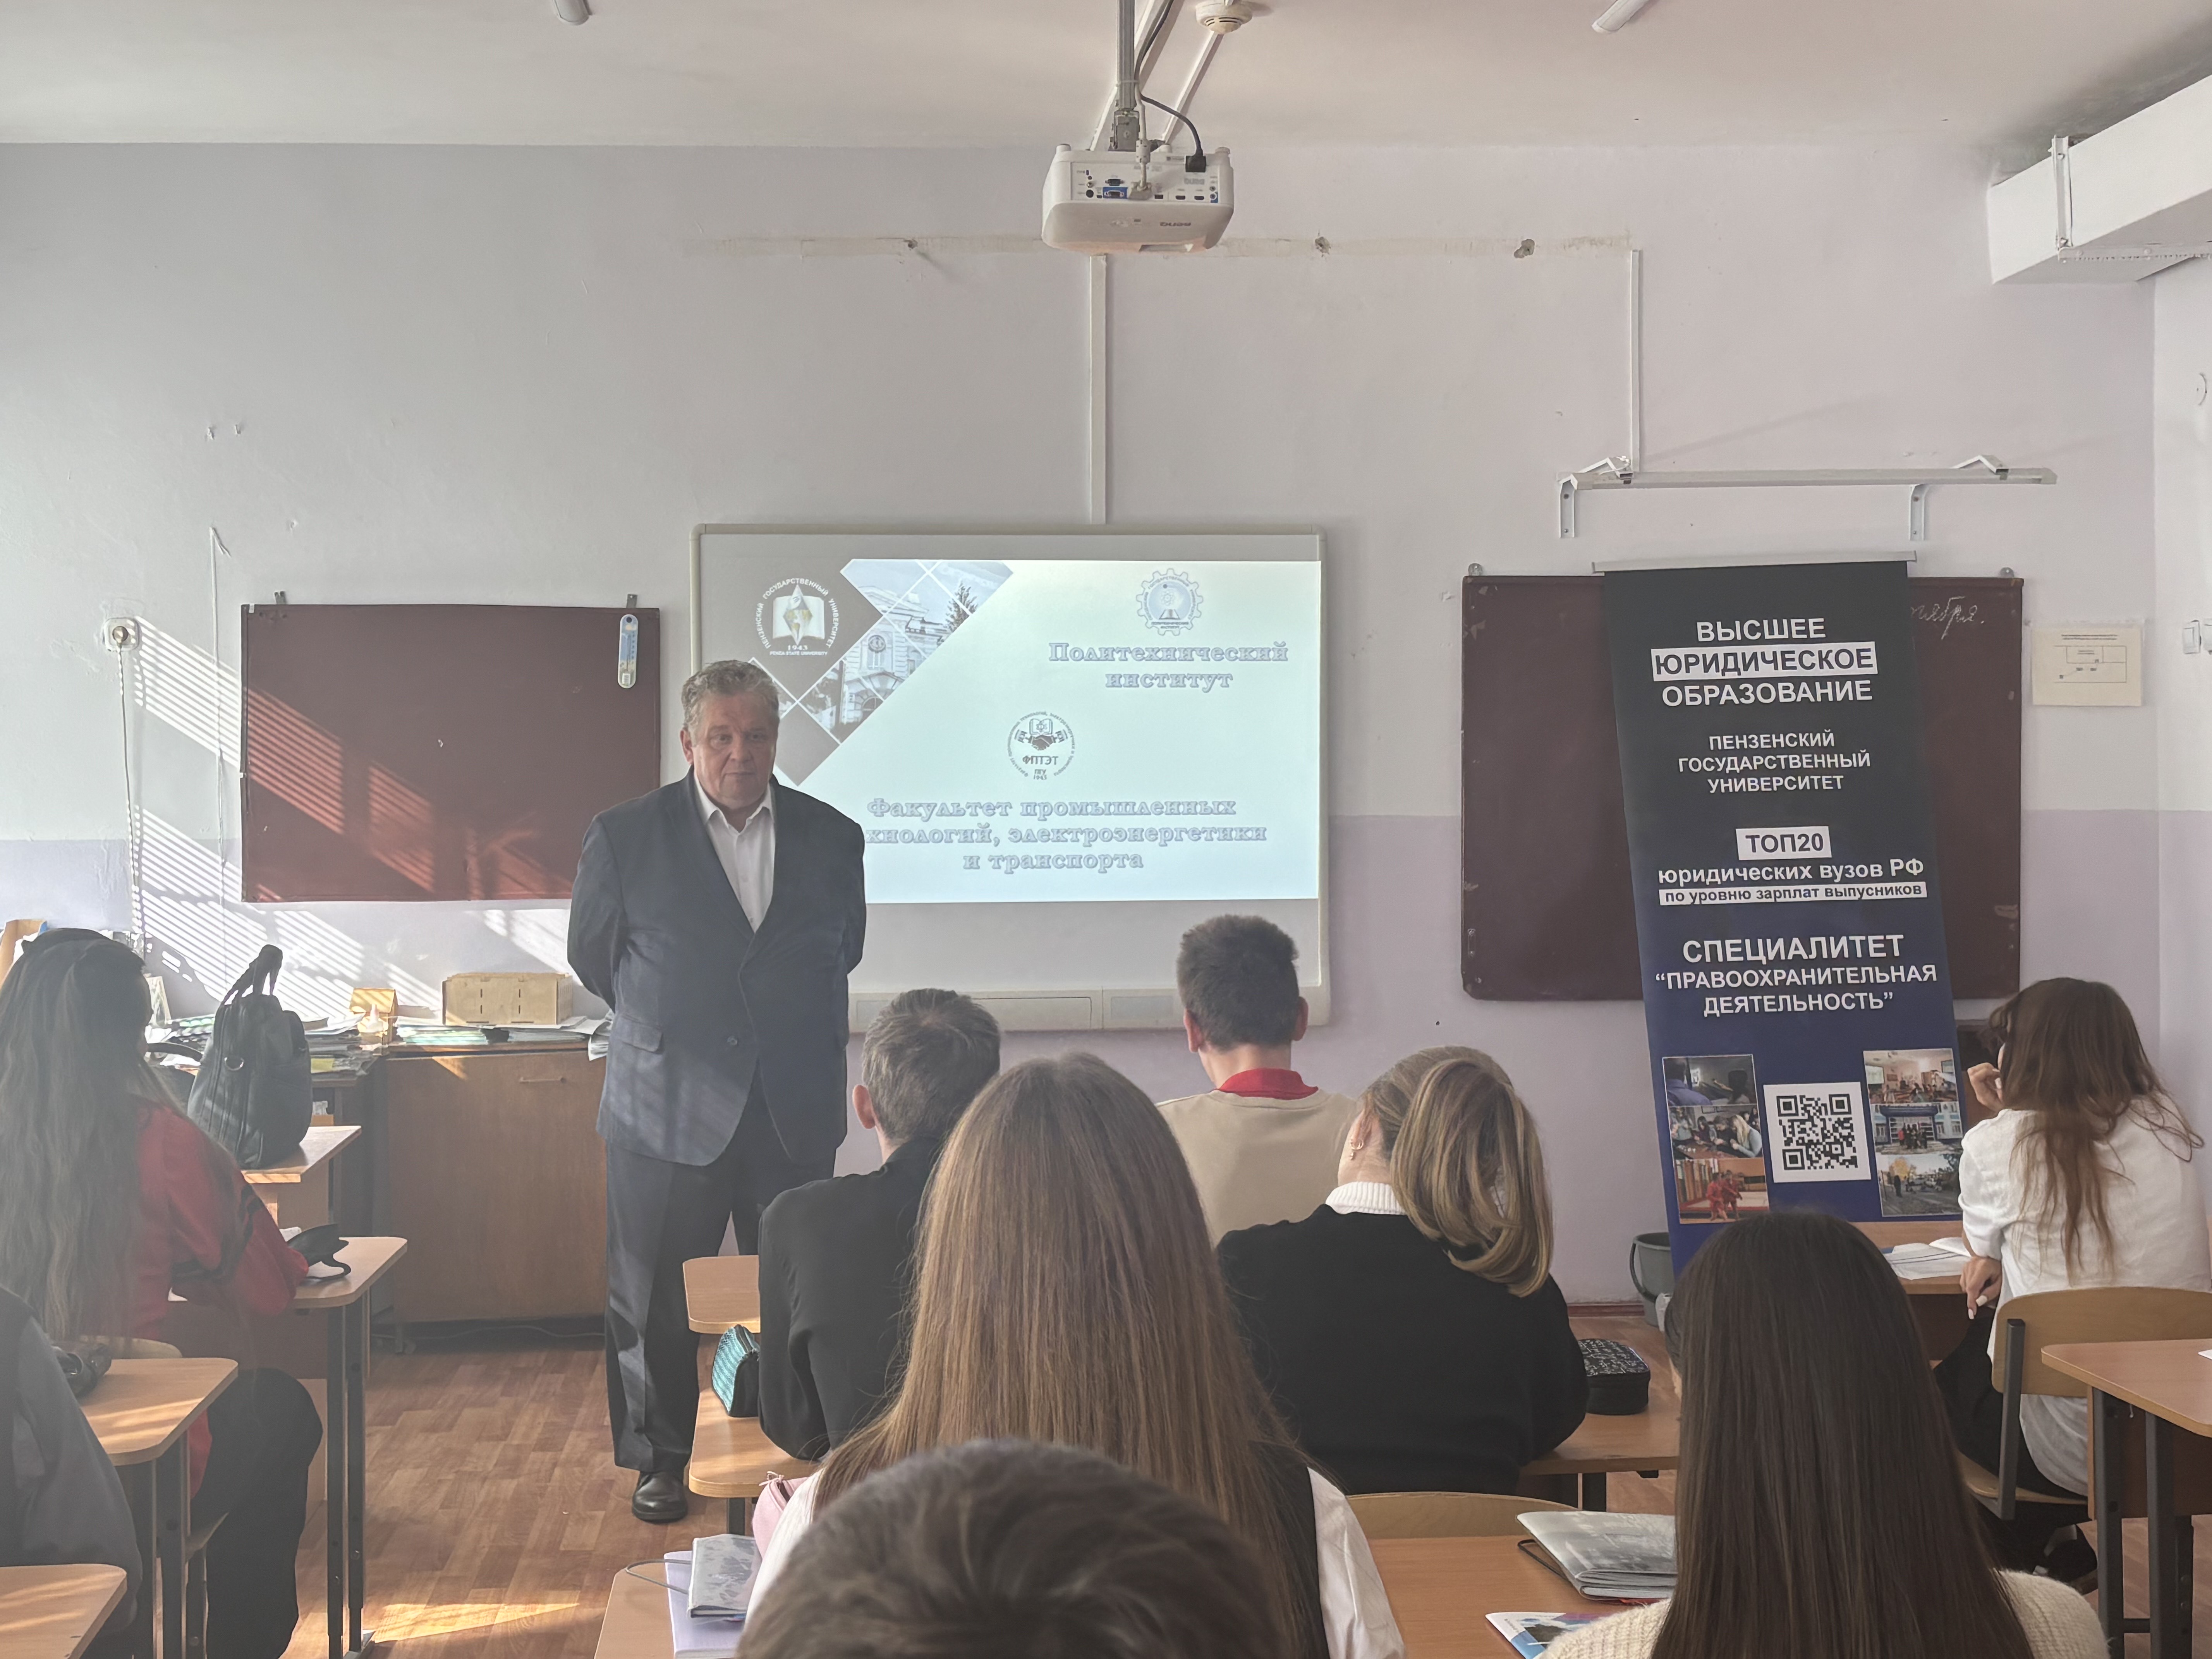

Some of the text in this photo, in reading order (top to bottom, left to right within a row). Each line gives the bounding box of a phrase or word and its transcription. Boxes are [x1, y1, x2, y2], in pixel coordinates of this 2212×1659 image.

[756, 578, 839, 649] ПЕНЗЕНСКИЙ ГОСУДАРСТВЕННЫЙ УНИВЕРСИТЕТ
[1697, 617, 1826, 642] ВЫСШЕЕ
[1048, 641, 1289, 662] Политехнический
[1655, 647, 1874, 676] ЮРИДИЧЕСКОЕ
[1105, 673, 1233, 693] институт
[1662, 680, 1873, 707] ОБРАЗОВАНИЕ
[1709, 729, 1834, 750] ПЕНЗЕНСКИЙ
[1022, 756, 1059, 765] ФПТЭТ
[1678, 750, 1870, 773] ГОСУДАРСТВЕННЫЙ
[1707, 775, 1844, 793] УНИВЕРСИТЕТ
[867, 798, 1237, 822] Факультет промышленных
[866, 822, 1267, 847] хнологий, электроэнергетики
[1745, 833, 1824, 853] ТОП20
[963, 853, 1144, 875] и транспорта
[1658, 858, 1924, 886] юридических вузов РФ
[1665, 884, 1922, 905] по уровню зарплат выпусников
[1683, 934, 1904, 965] СПЕЦИАЛИТЕТ
[1656, 964, 1937, 990] “ПРАВООХРАНИТЕЛЬНАЯ
[1704, 991, 1893, 1017] ДЕЯТЕЛЬНОСТЬ”
